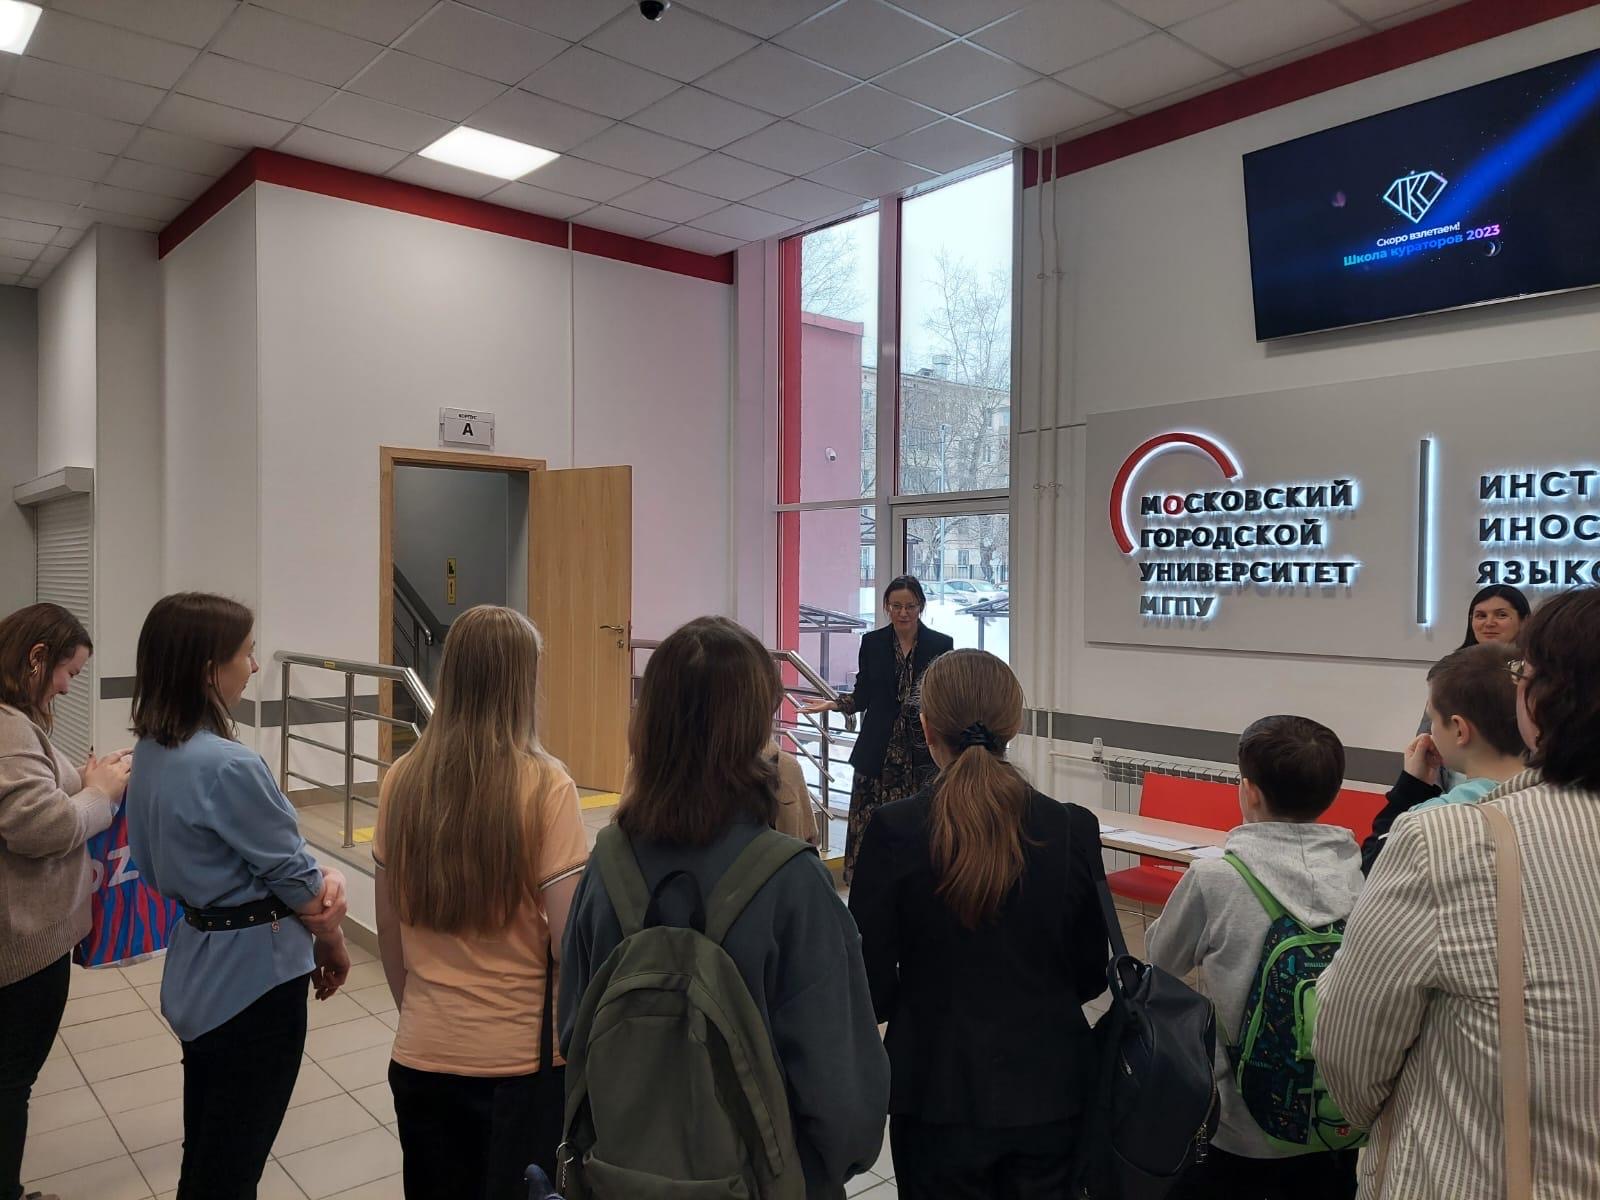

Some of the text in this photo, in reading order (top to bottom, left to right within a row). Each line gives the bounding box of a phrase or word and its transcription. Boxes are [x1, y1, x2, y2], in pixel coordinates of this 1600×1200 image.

[1343, 223, 1502, 267] Школа кураторов 2023
[1376, 222, 1461, 248] Скоро взлетаем!
[462, 422, 474, 436] А
[1140, 479, 1354, 515] МОСКОВСКИЙ
[1479, 470, 1599, 500] ИНСТ
[1140, 518, 1323, 550] ГОРОДСКОЙ
[1479, 514, 1600, 542] ИНОС
[1138, 561, 1356, 584] УНИВЕРСИТЕТ
[1139, 595, 1216, 617] МГПУ
